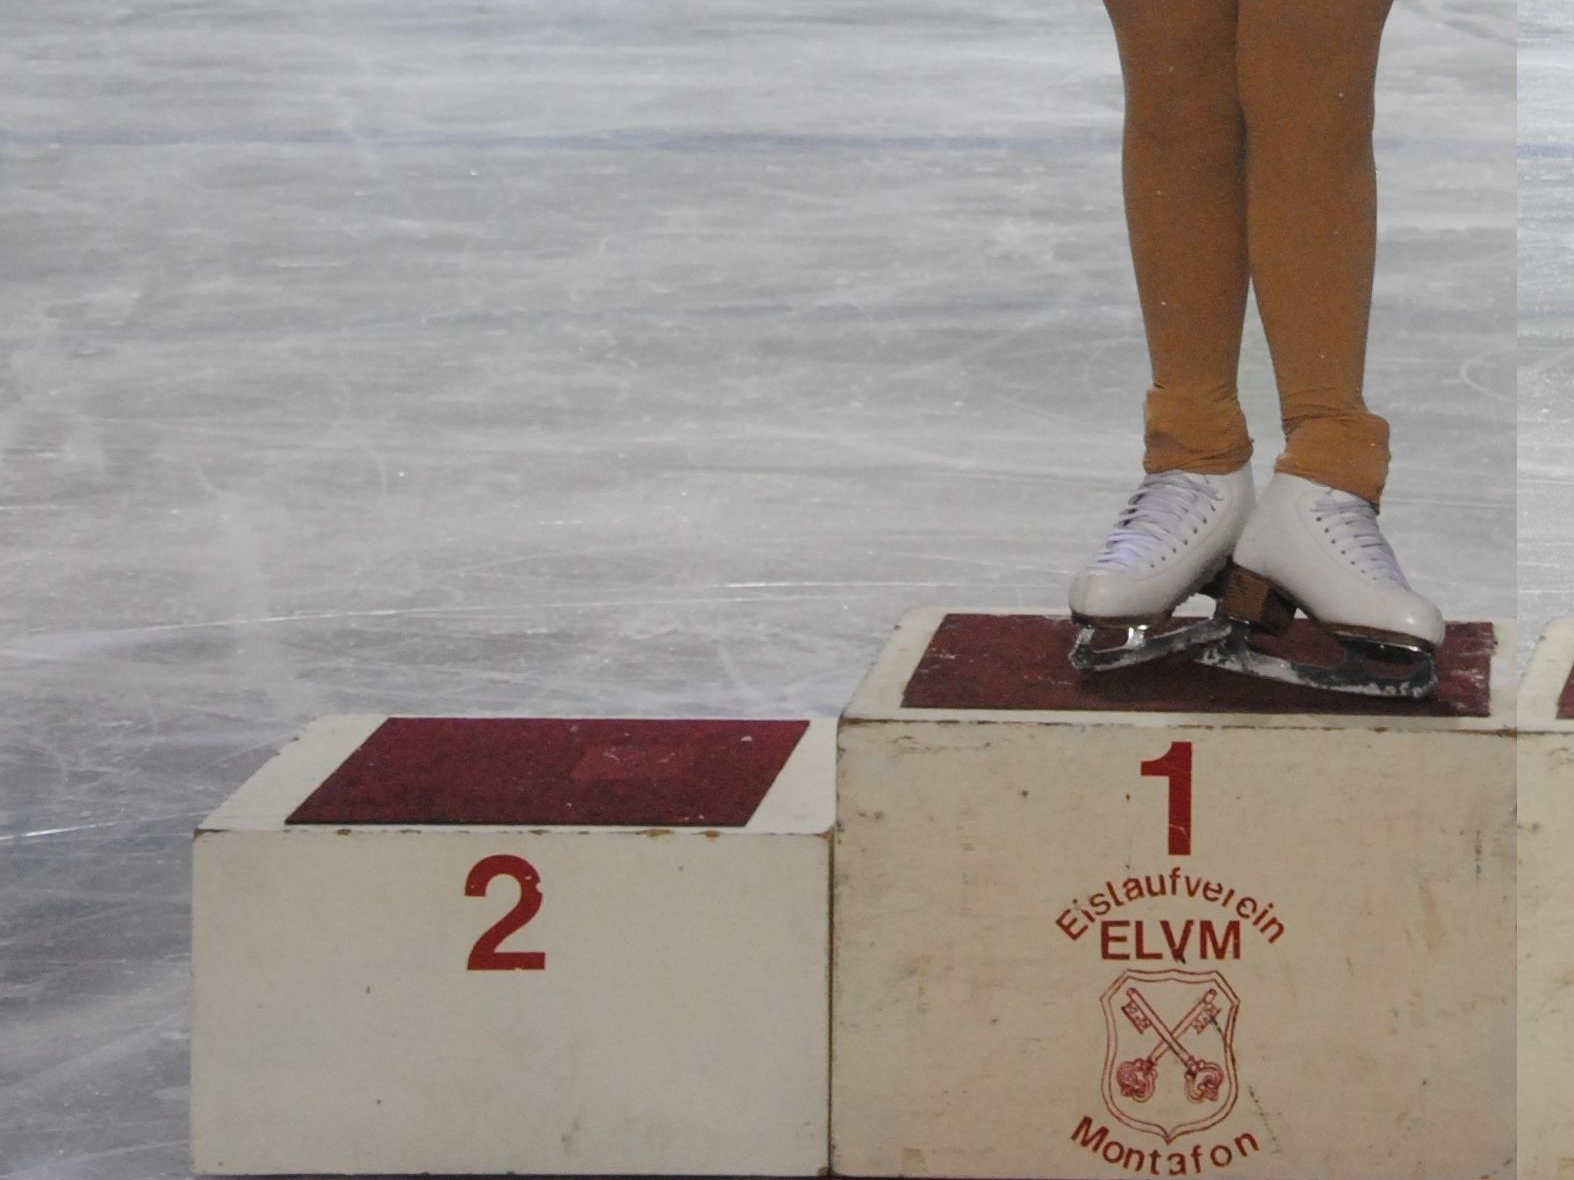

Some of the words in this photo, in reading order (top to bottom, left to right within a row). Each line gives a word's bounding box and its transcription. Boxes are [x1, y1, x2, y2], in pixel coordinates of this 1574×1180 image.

[1140, 741, 1192, 855] 1
[464, 854, 546, 971] 2
[1055, 867, 1285, 944] Eislaufverein
[1100, 920, 1241, 961] ELVM
[1071, 1116, 1259, 1176] Montafon
